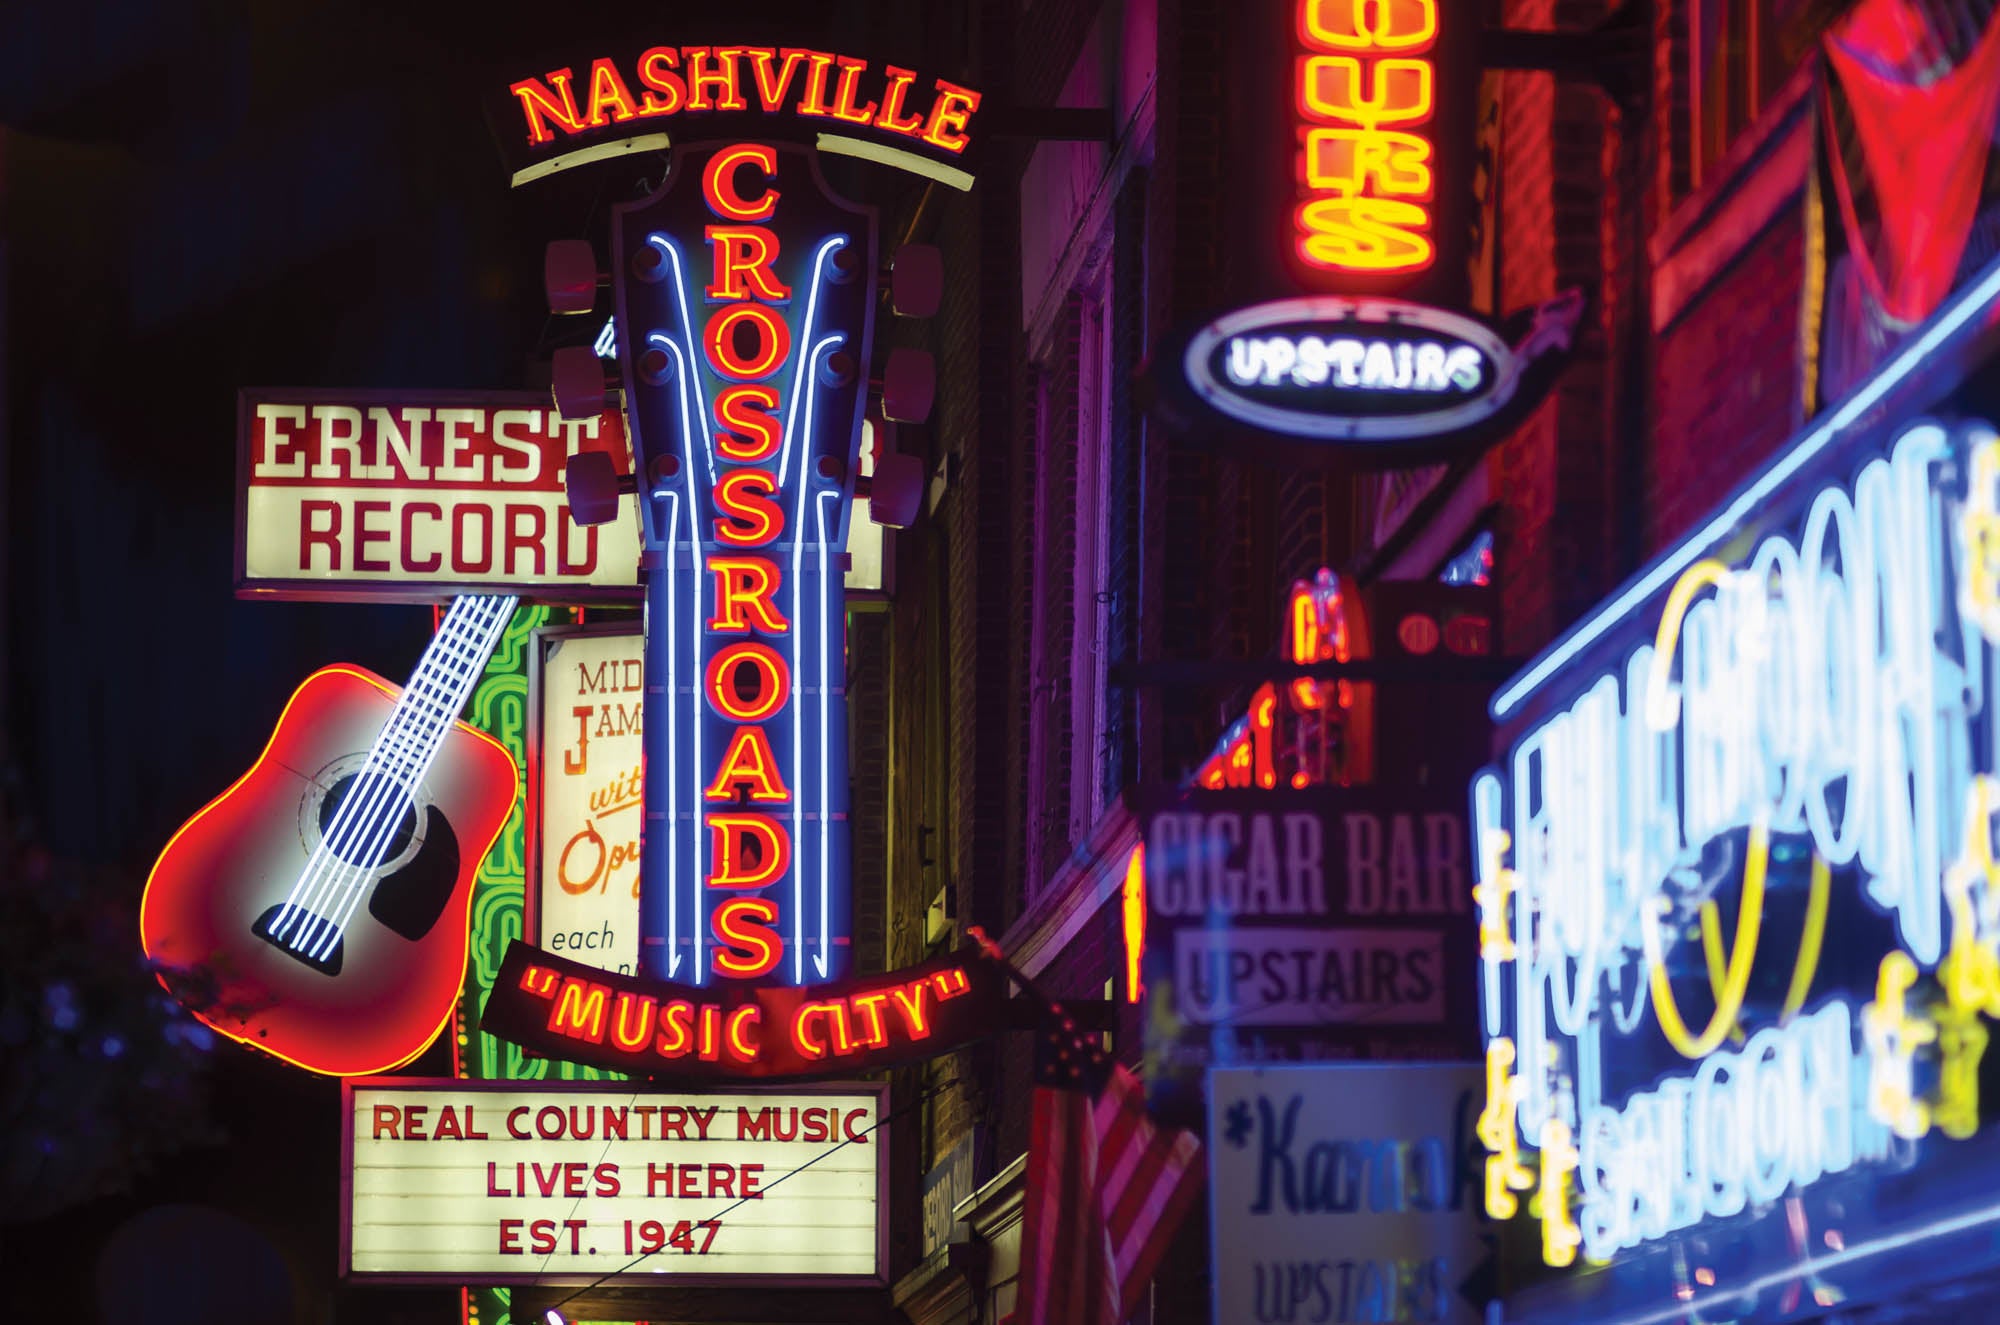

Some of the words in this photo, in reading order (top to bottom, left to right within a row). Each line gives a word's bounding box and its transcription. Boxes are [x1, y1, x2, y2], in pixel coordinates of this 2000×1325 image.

[510, 45, 982, 154] NASHVILLE
[1226, 336, 1483, 391] UPSTAIRS
[254, 403, 599, 484] ERNEST
[299, 499, 598, 576] RECORD
[701, 143, 792, 979] CROSSROADS
[1151, 812, 1328, 916] CIGAR
[1344, 812, 1466, 916] BAR
[551, 920, 614, 951] each
[1186, 947, 1437, 1004] UPSTAIRS
[373, 1104, 488, 1140] REAL
[506, 1105, 719, 1142] COUNTRY
[737, 1106, 868, 1143] MUSIC
[487, 1161, 621, 1198] LIVES
[647, 1162, 764, 1199] HERE
[500, 1219, 598, 1255] EST.
[624, 1219, 723, 1255] 1947
